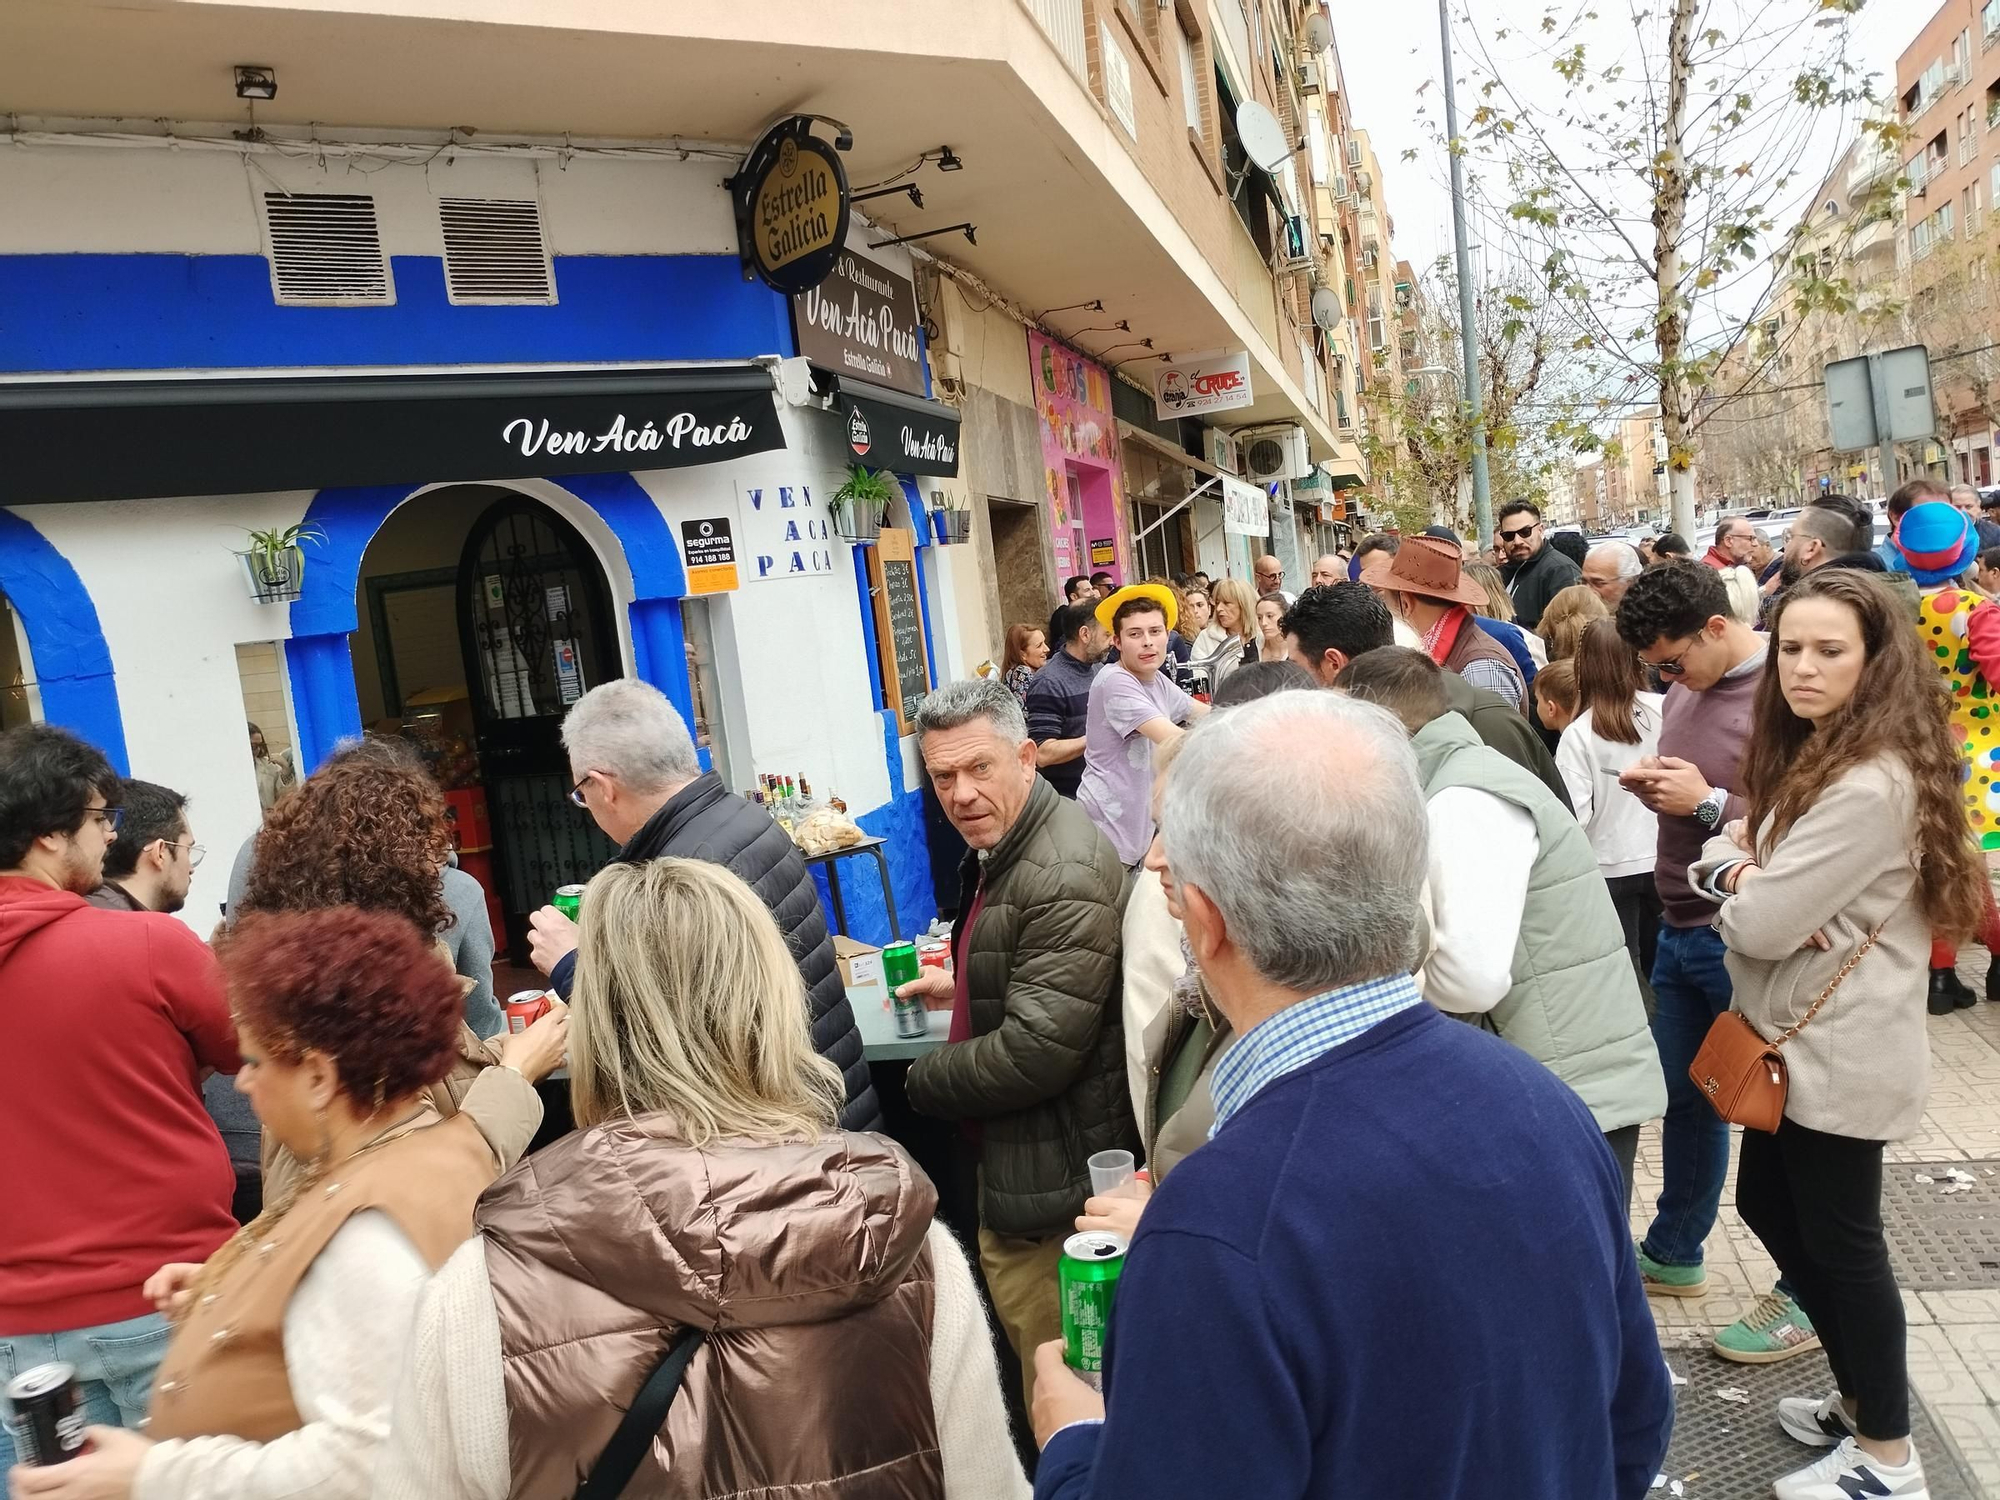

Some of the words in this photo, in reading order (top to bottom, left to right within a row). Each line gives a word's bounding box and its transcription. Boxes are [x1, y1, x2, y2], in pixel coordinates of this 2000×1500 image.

[762, 169, 827, 227] Estrella
[768, 207, 828, 261] Galicia
[845, 257, 894, 300] Restaurante
[797, 284, 843, 336] Ven
[845, 290, 880, 348] Acá
[880, 304, 919, 362] Pacá
[844, 348, 867, 371] Estrella
[866, 355, 886, 377] Galicia
[1197, 399, 1212, 407] 924
[503, 418, 592, 456] Ven
[592, 414, 664, 451] Acá
[666, 412, 752, 449] Pacá
[901, 425, 920, 459] Ven
[920, 430, 937, 460] Acá
[937, 434, 955, 463] Pacá
[747, 486, 811, 511] VEN
[686, 536, 730, 548] segurma
[784, 519, 828, 542] ACA
[691, 555, 703, 564] 914
[704, 554, 717, 563] 188
[718, 553, 731, 561] 188
[757, 550, 831, 577] PACA
